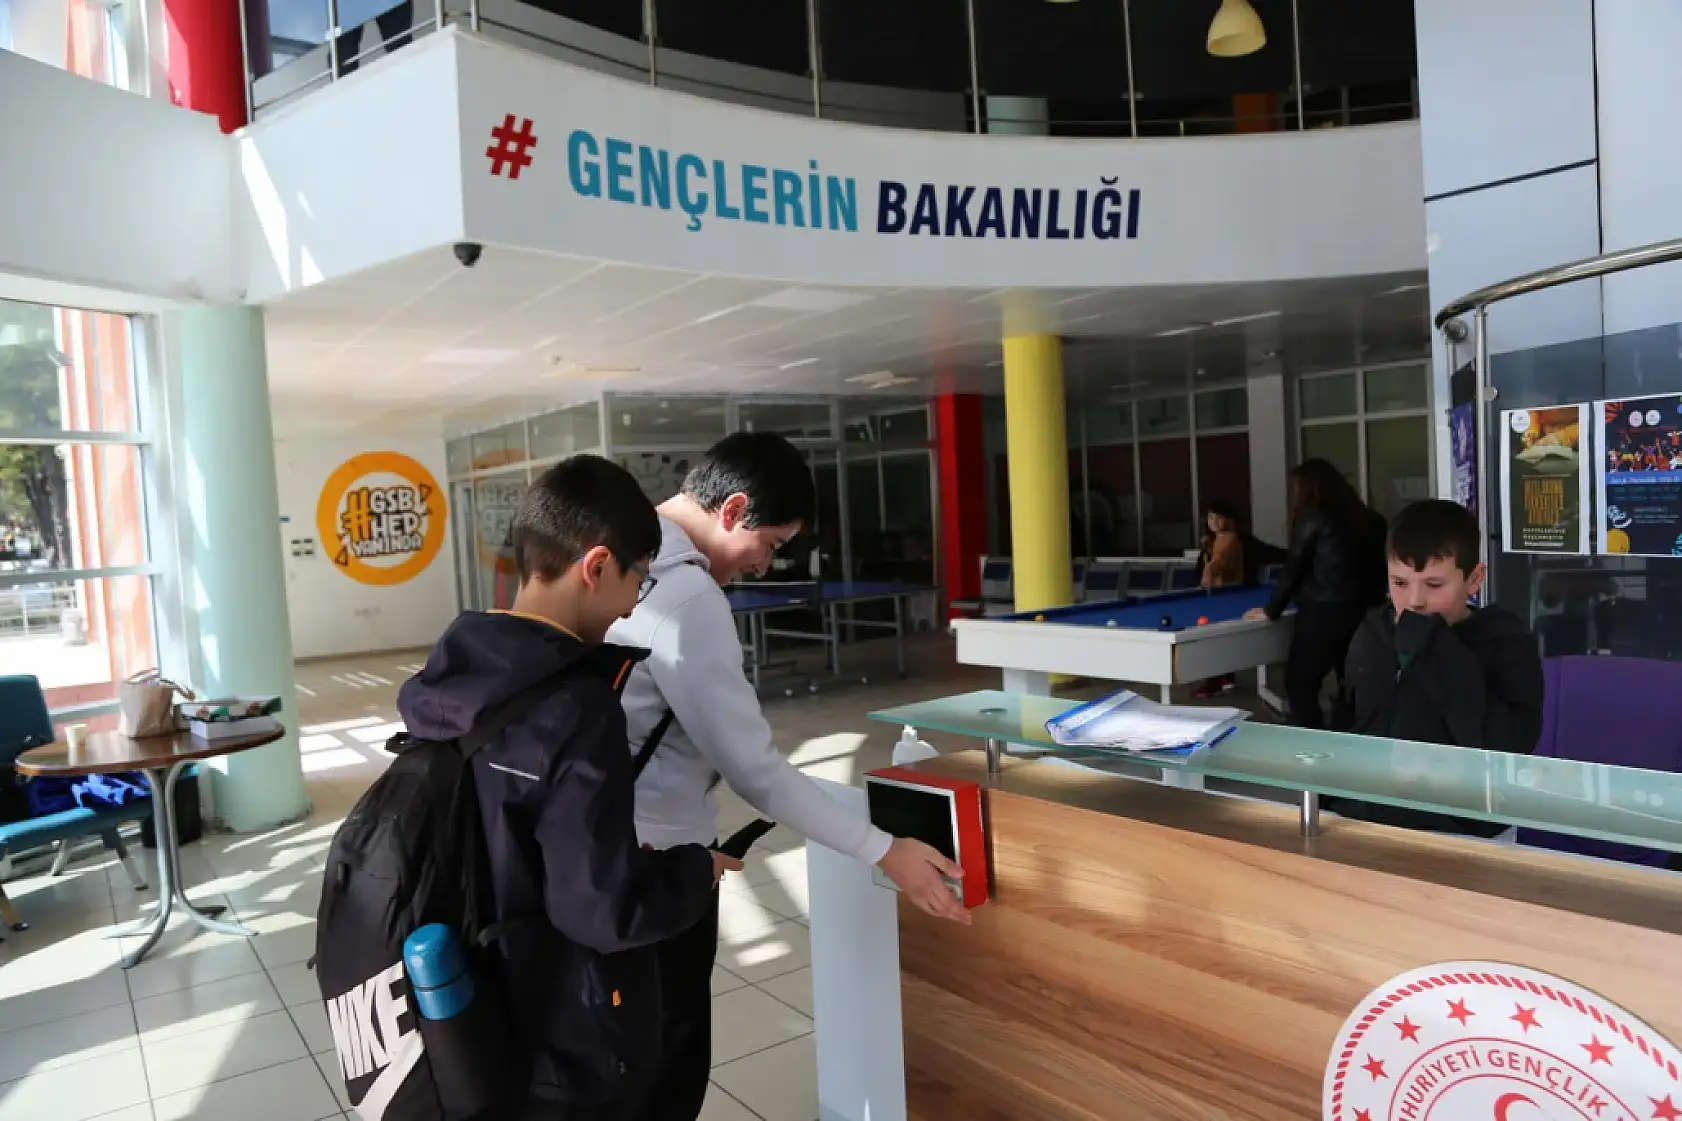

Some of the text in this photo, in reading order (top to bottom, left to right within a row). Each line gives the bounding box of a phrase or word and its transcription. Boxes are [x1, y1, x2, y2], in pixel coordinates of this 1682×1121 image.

[485, 112, 1141, 240] # GENÇLERİN BAKANLIĞI
[326, 960, 421, 1081] NIKE
[1398, 1045, 1609, 1121] HURİYETİ GENÇLİK
